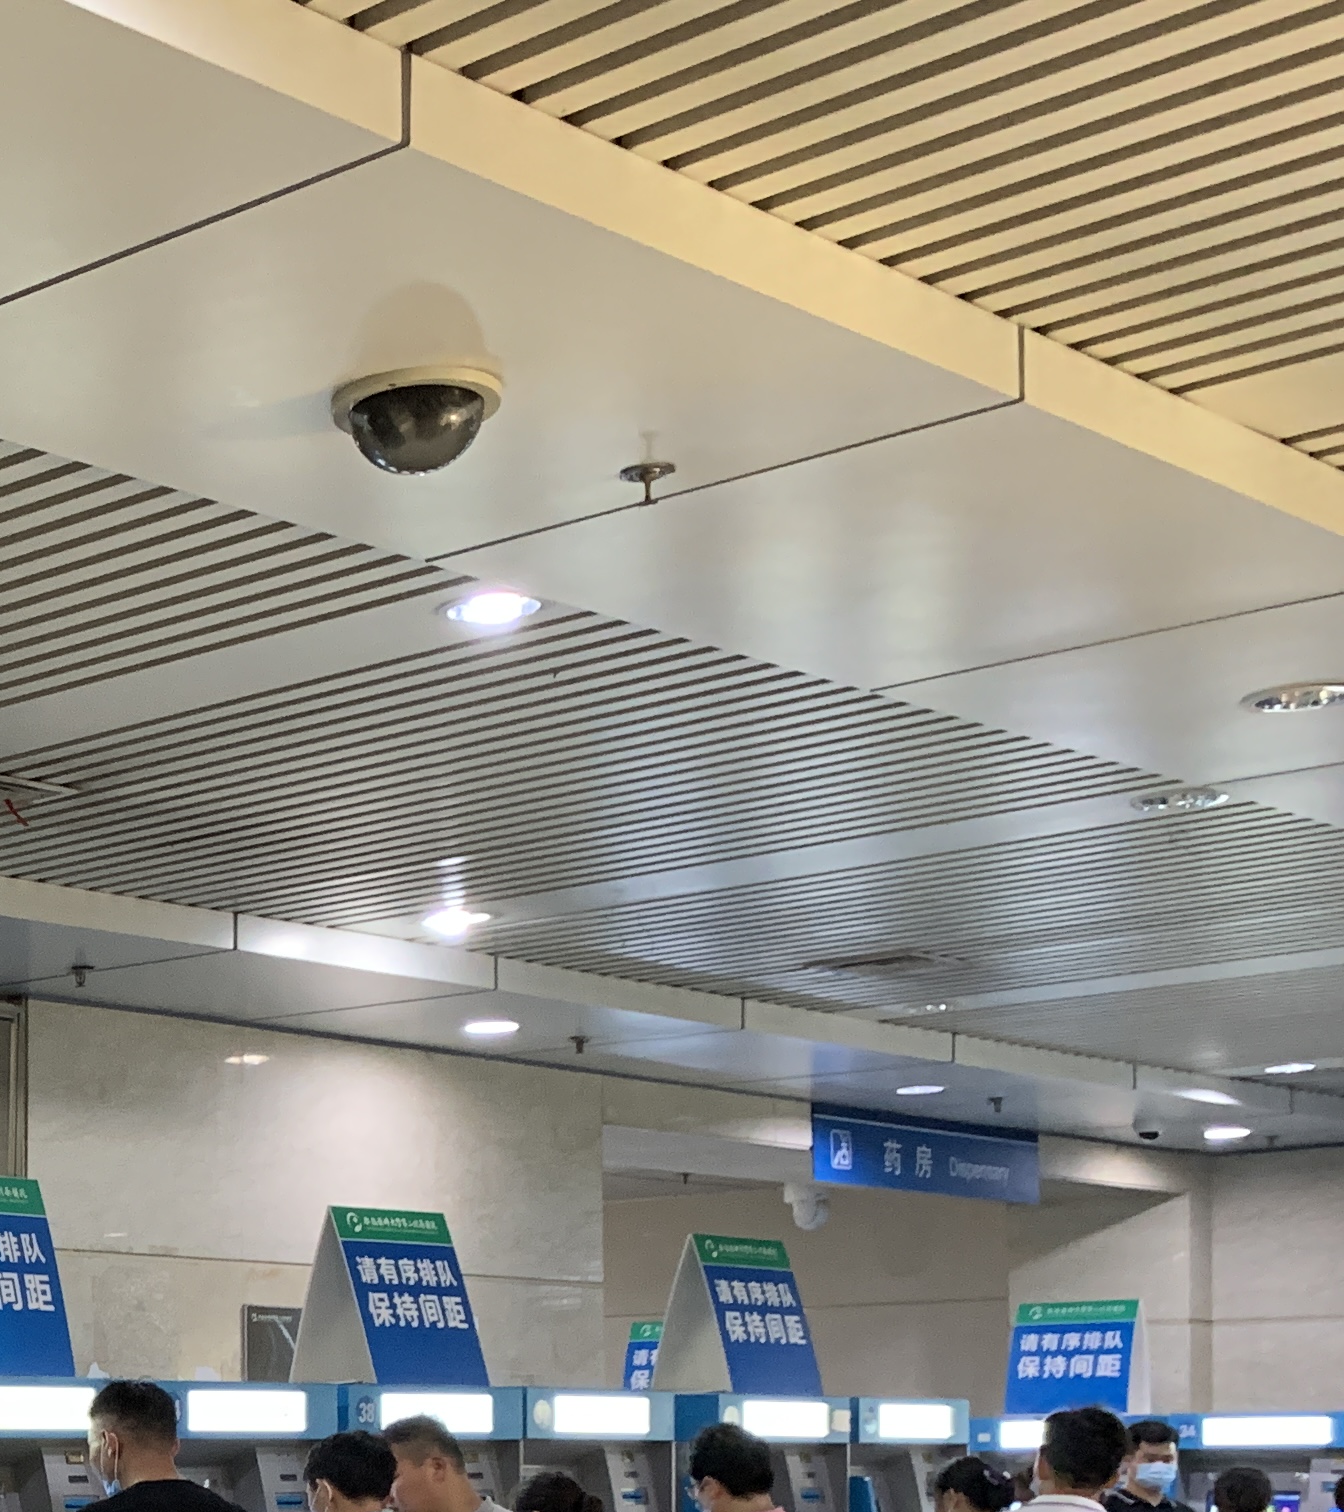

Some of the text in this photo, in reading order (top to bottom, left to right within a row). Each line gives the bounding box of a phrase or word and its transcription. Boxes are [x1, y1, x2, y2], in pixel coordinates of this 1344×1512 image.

[884, 1138, 933, 1179] 药房
[356, 1255, 458, 1287] 请有序排队
[714, 1278, 797, 1308] 请有序排队
[368, 1291, 469, 1329] 保持间距
[724, 1310, 807, 1345] 保持间距
[1020, 1330, 1123, 1352] 请有序排队
[1017, 1354, 1123, 1379] 保持间距
[358, 1402, 375, 1423] 38
